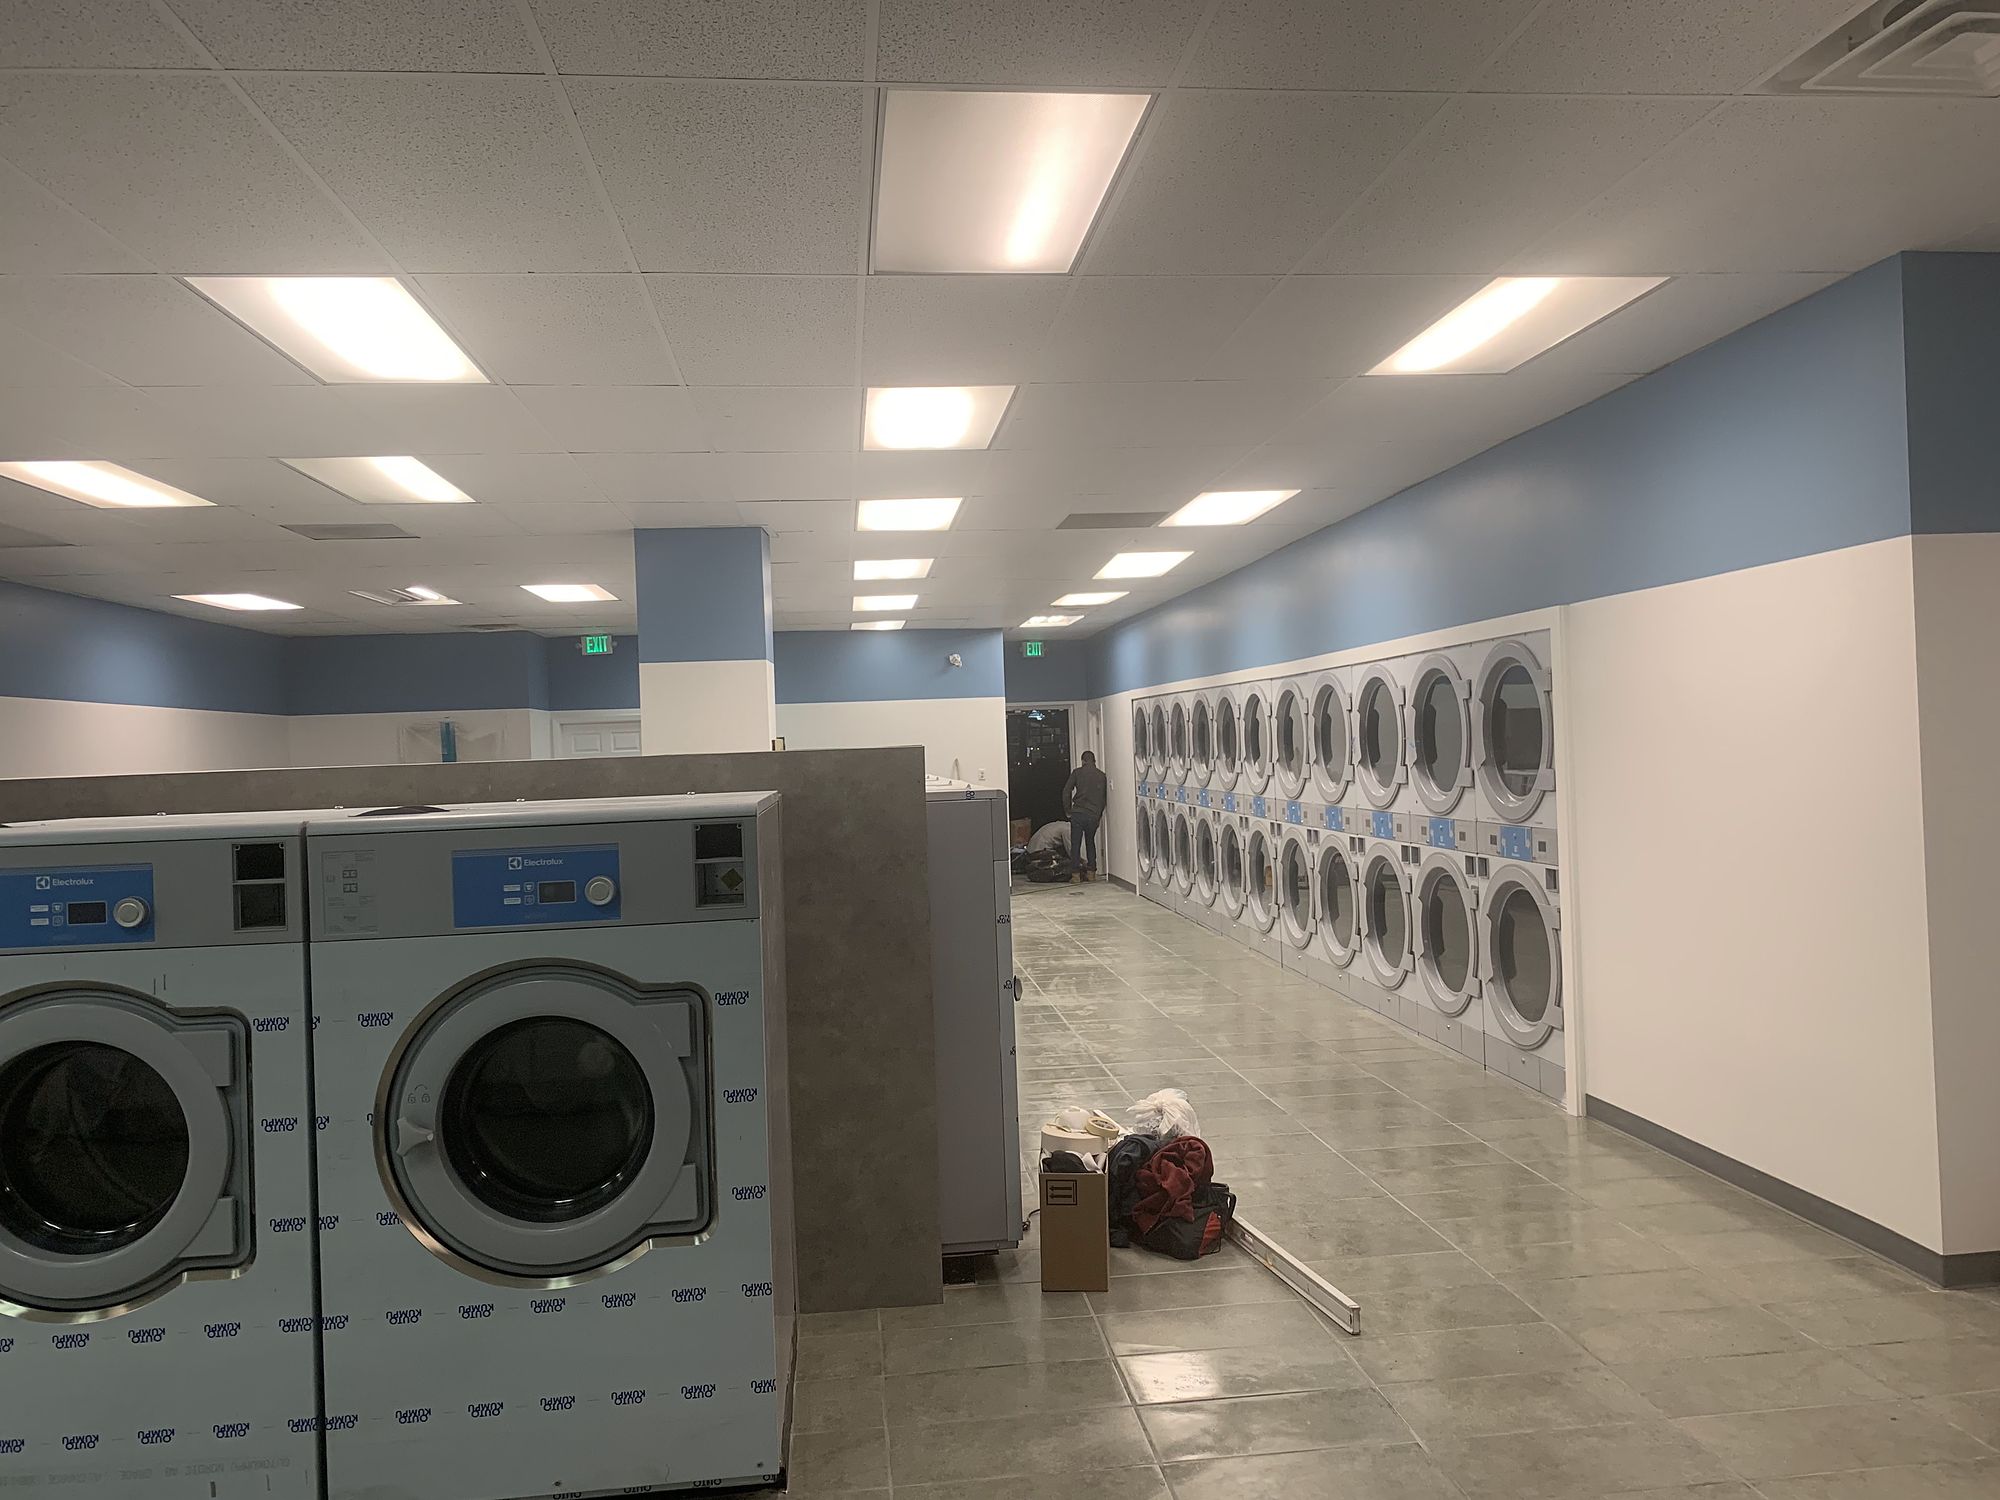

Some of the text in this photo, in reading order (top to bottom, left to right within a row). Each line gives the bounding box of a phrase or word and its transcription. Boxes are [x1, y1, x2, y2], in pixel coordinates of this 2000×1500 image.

[586, 636, 608, 653] EXIT
[1027, 642, 1042, 656] EXIT
[523, 858, 564, 867] Electrolux
[52, 877, 94, 887] Electrolux
